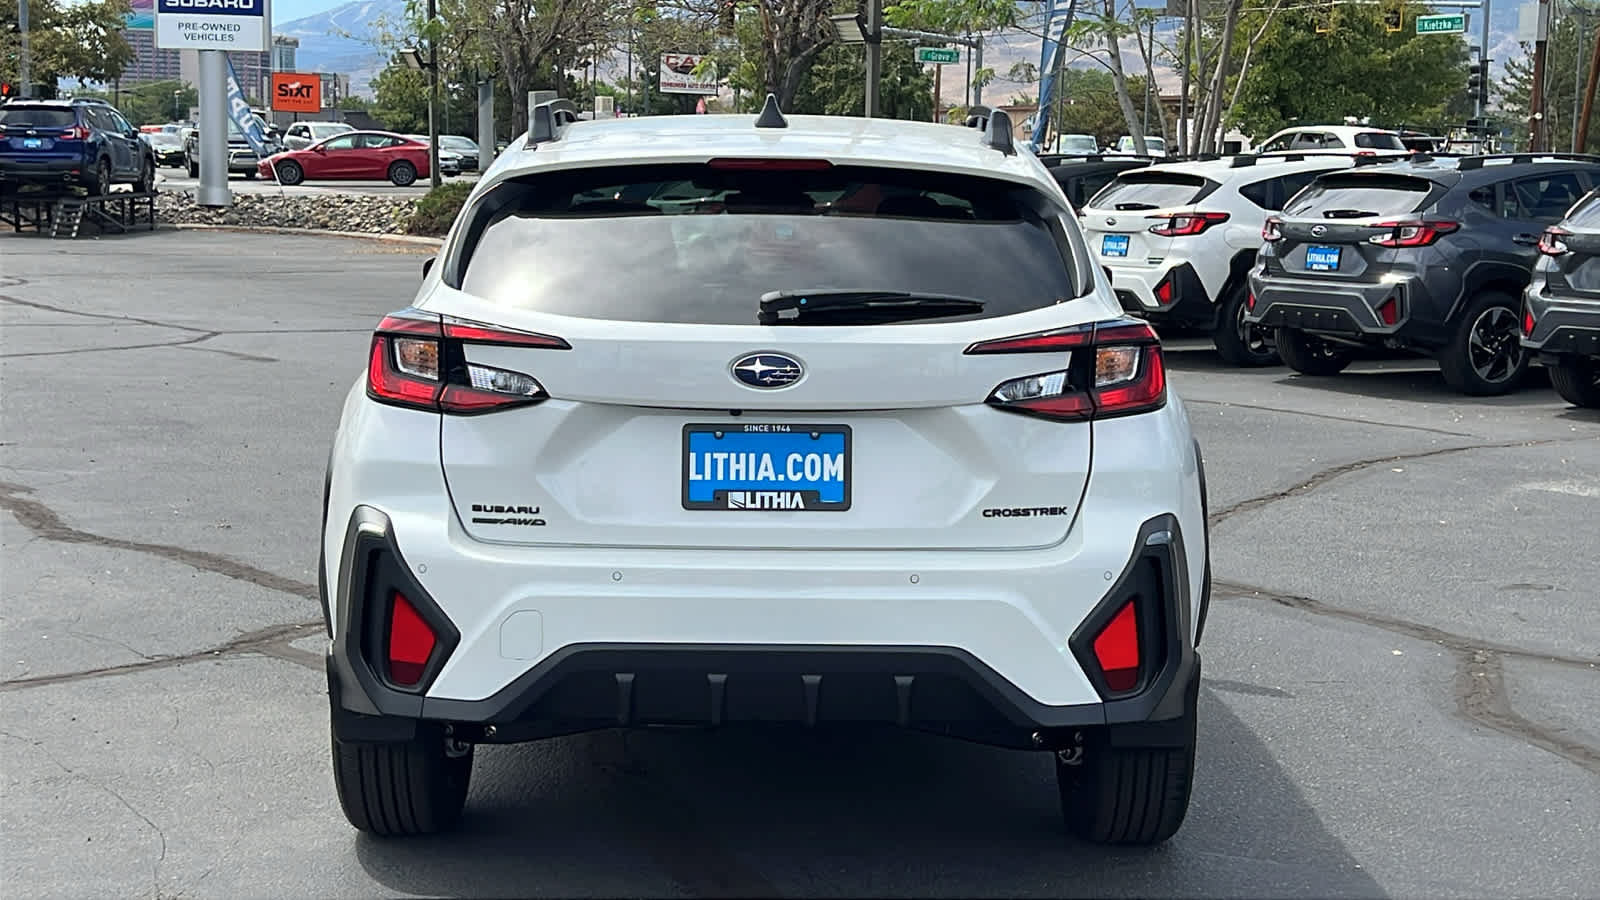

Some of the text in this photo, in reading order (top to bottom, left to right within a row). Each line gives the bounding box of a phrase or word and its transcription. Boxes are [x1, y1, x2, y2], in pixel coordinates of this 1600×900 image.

[165, 0, 254, 9] SUBARU
[177, 22, 241, 32] PRE-OWNED
[184, 33, 235, 41] VEHICLES
[744, 424, 791, 433] SINCE 1946
[689, 452, 844, 482] LITHIA.COM
[745, 491, 806, 509] LITHIA
[472, 504, 540, 515] SUBARU
[982, 506, 1068, 518] CROSSTREK
[500, 518, 546, 526] AWD
